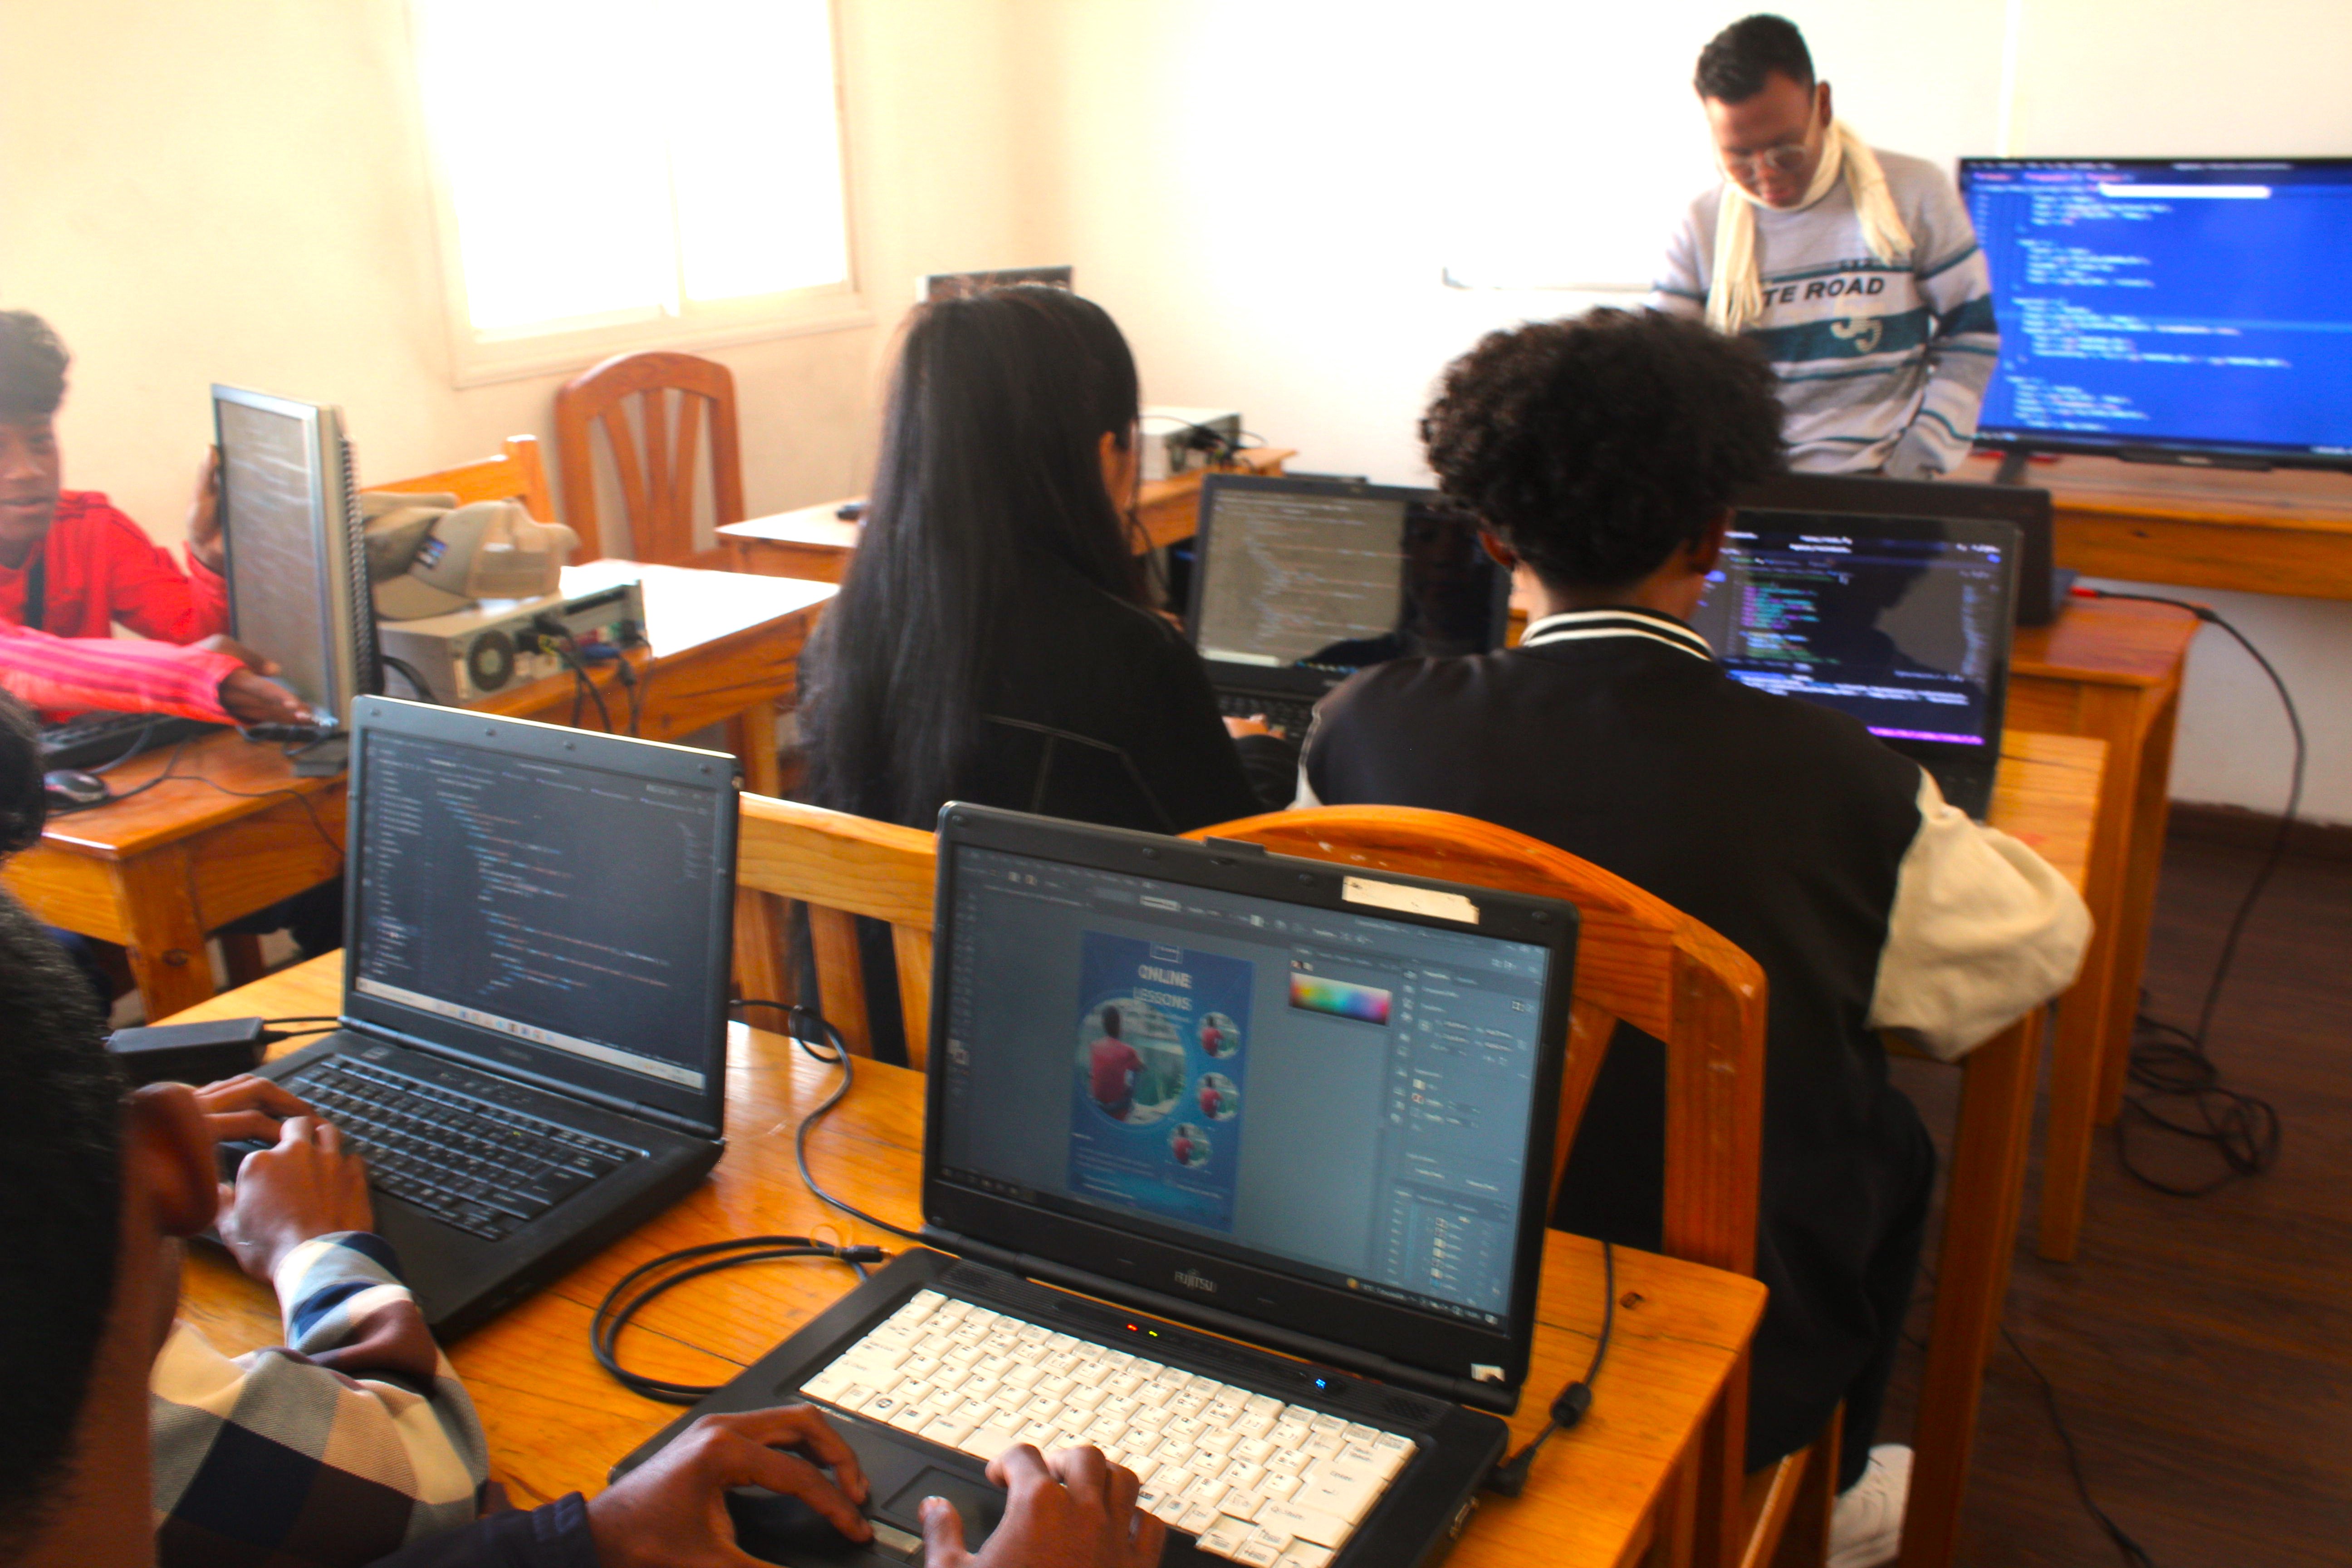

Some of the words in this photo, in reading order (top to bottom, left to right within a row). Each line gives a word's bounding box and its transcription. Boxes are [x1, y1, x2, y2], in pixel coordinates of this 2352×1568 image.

[1762, 285, 1797, 308] TE
[1803, 276, 1886, 300] ROAD
[1138, 964, 1193, 989] ONLINE
[1133, 987, 1192, 1010] LESSONS
[1174, 1270, 1217, 1293] FUJITSU
